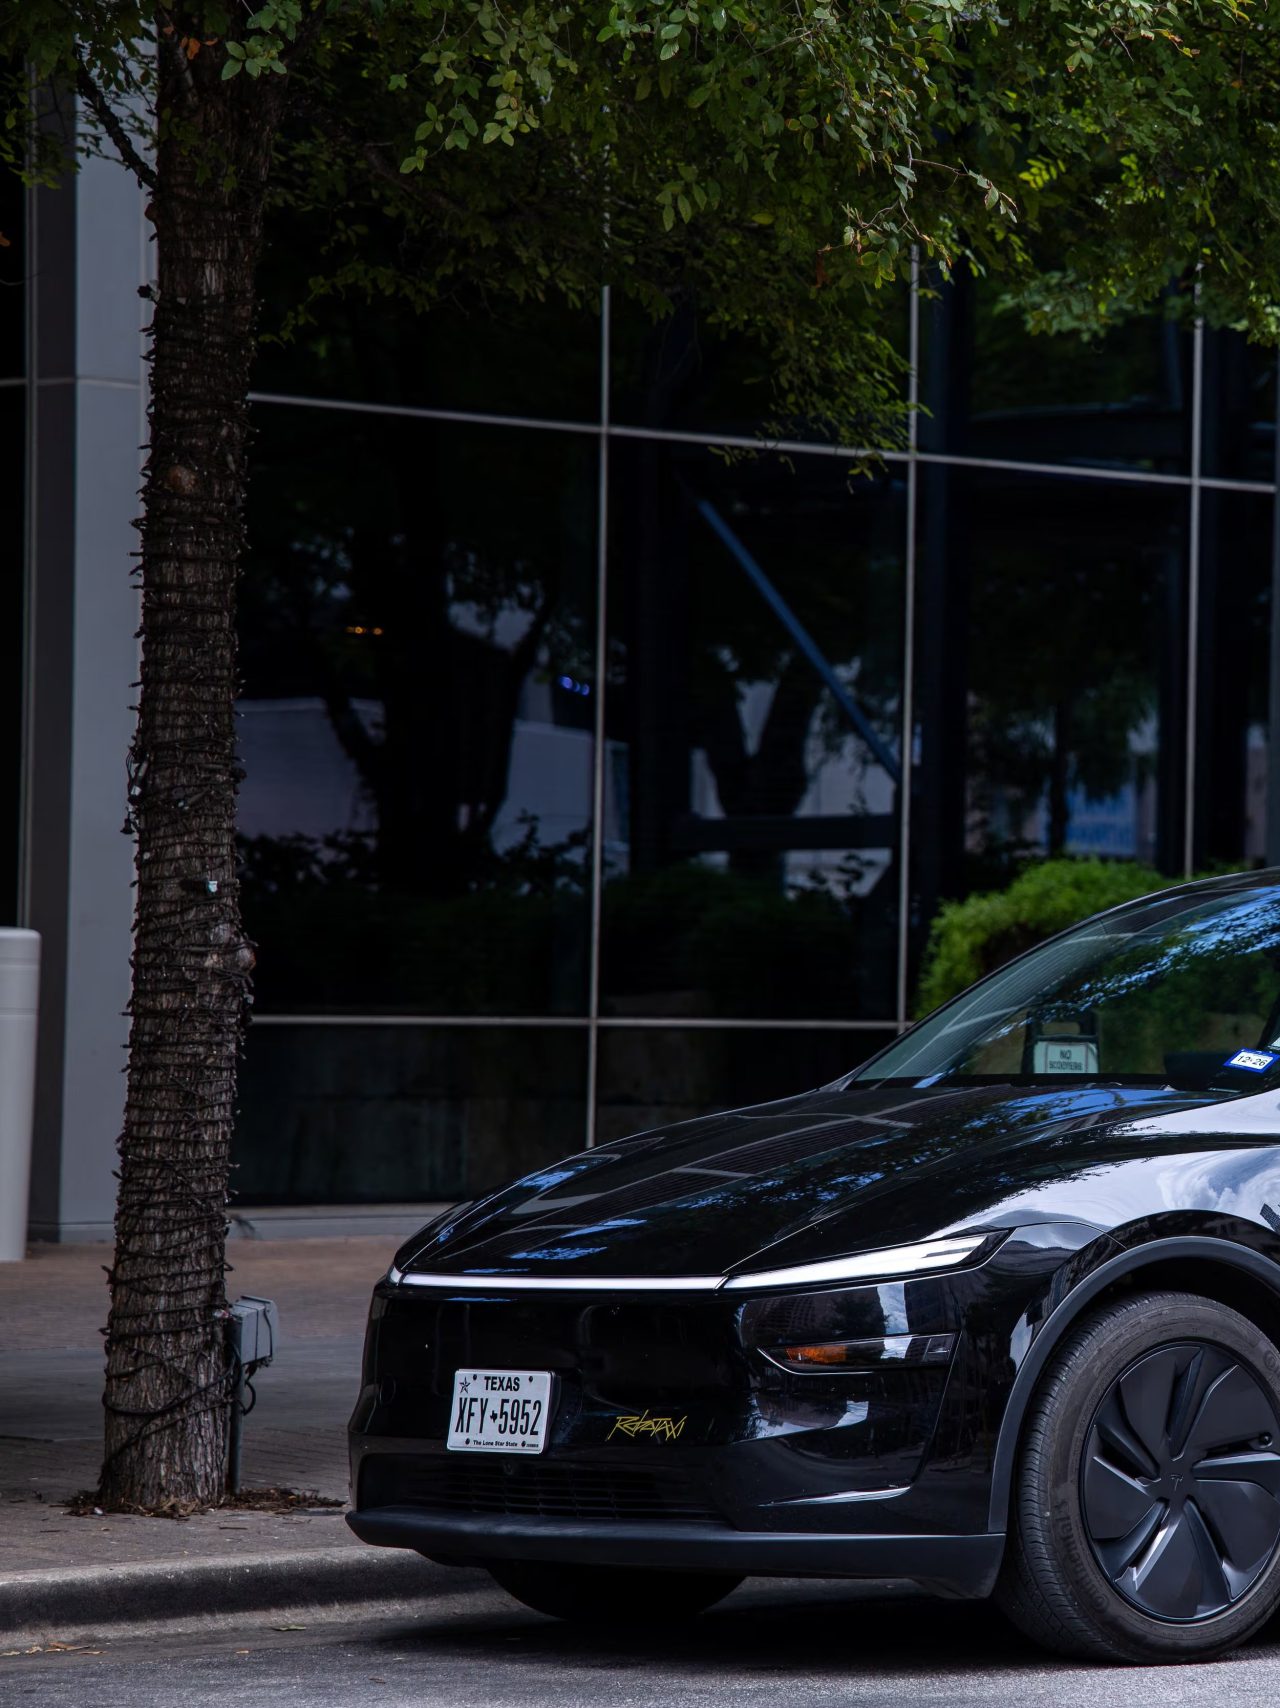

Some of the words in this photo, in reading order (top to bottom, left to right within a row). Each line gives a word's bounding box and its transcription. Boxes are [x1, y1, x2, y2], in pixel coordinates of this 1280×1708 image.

[1060, 1049, 1072, 1060] NO
[484, 1376, 520, 1391] TEXAS
[455, 1397, 488, 1433] XFY
[498, 1398, 542, 1435] 5952
